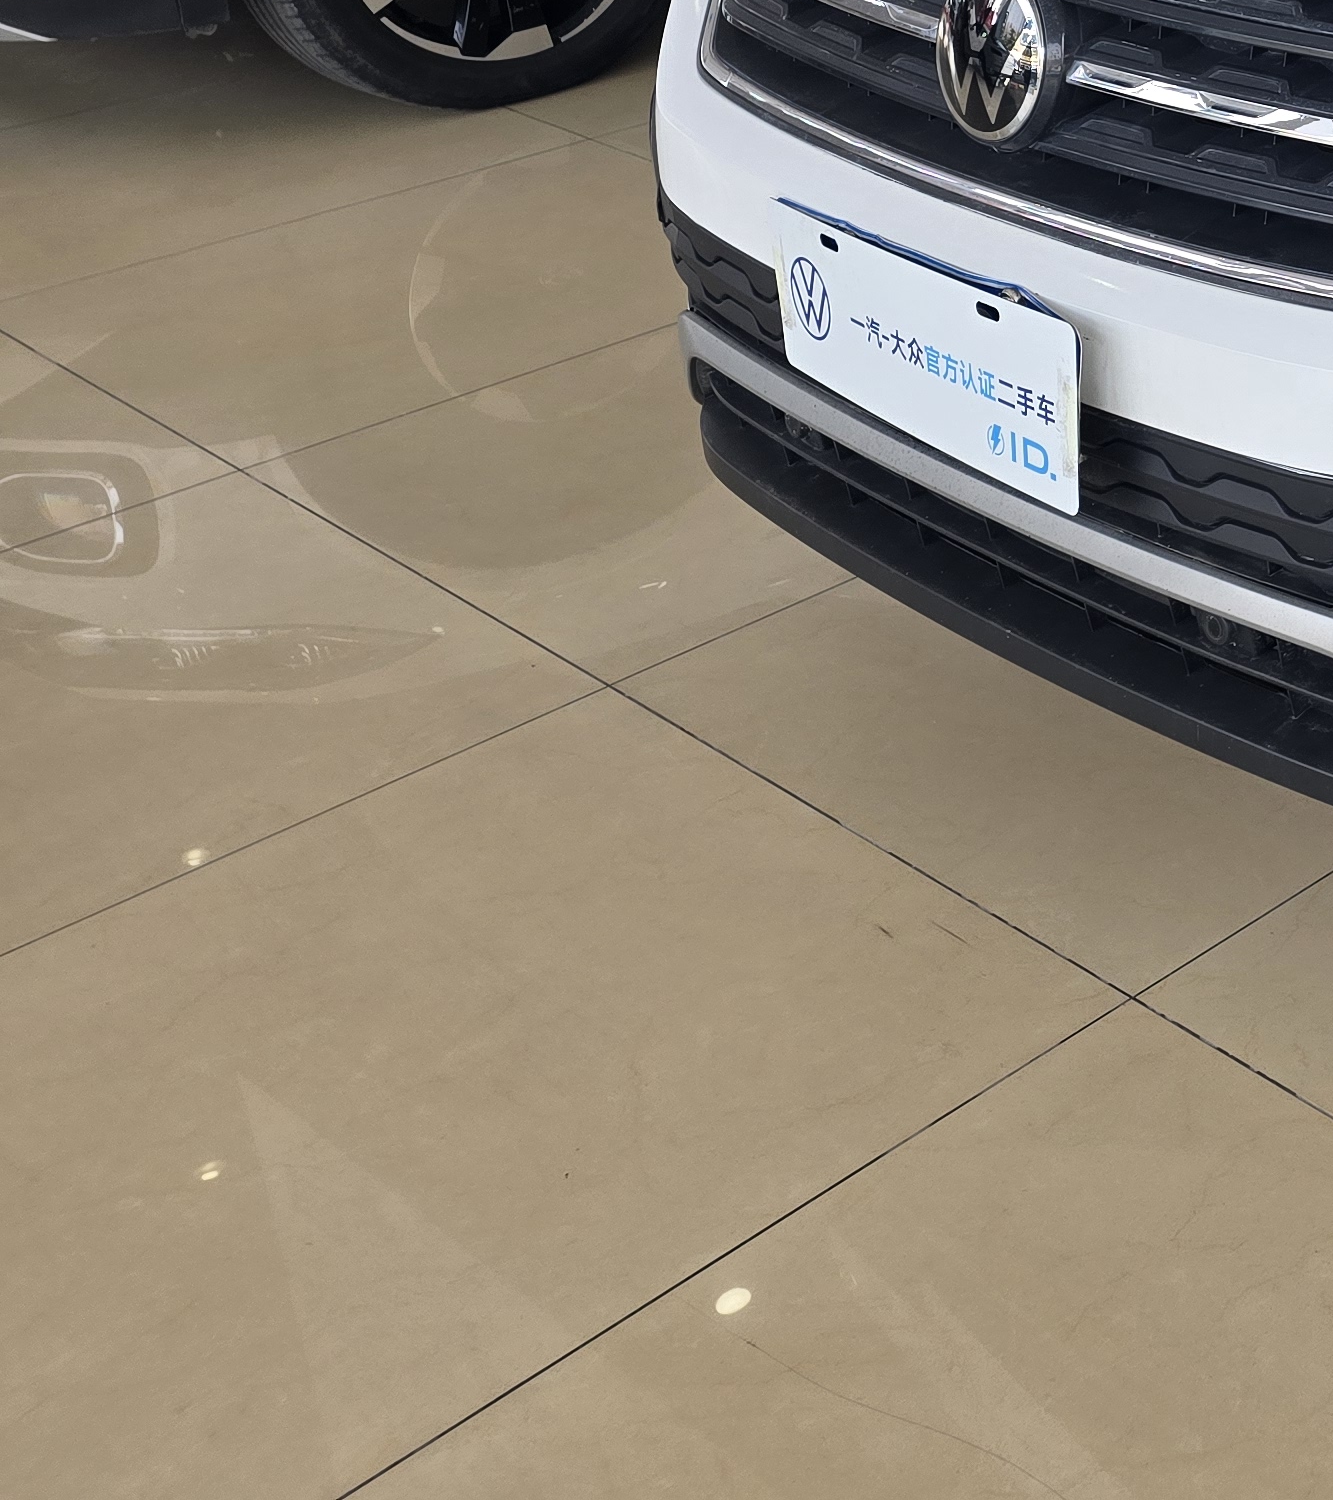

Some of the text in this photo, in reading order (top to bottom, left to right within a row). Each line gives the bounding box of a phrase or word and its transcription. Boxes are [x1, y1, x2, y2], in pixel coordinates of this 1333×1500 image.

[850, 315, 1056, 426] 一汽-大众官方认证二手车
